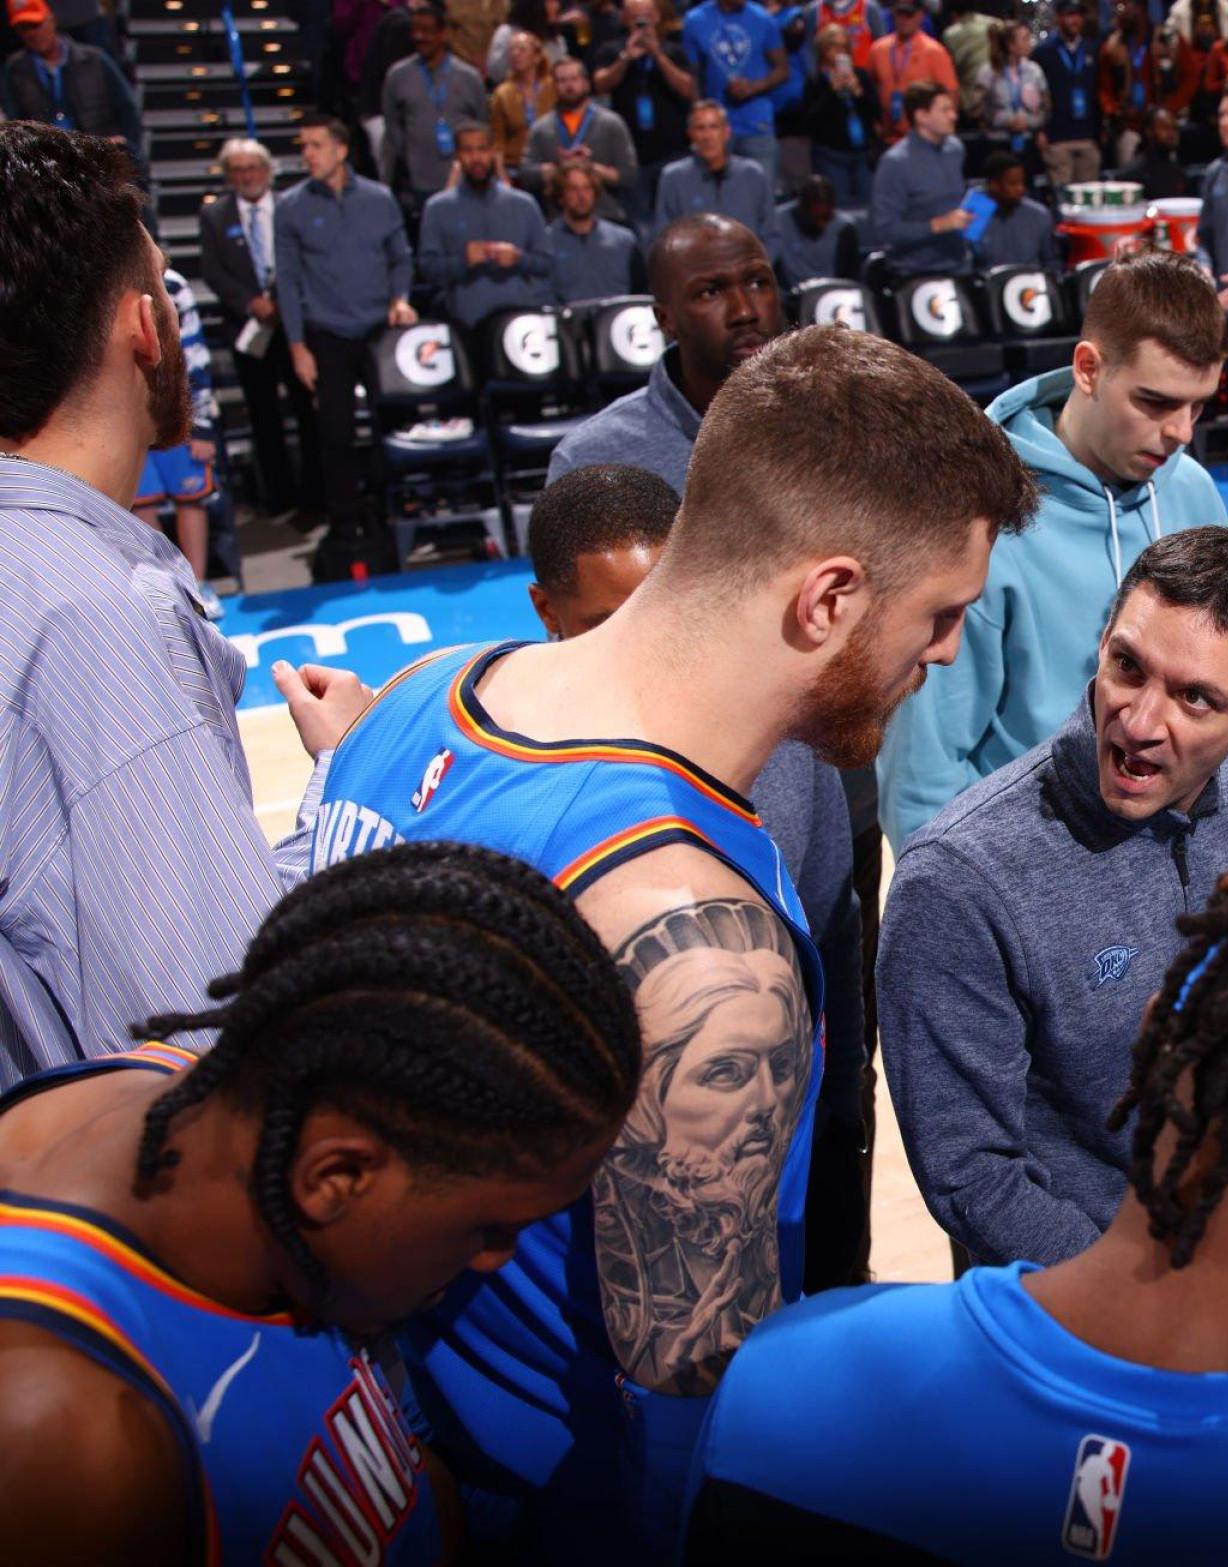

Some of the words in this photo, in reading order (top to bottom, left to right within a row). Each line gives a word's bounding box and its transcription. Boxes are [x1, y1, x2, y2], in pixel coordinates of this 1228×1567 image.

[911, 279, 963, 337] G
[1003, 272, 1052, 328] G
[395, 323, 456, 386] G
[503, 314, 559, 374] G
[611, 306, 665, 366] G
